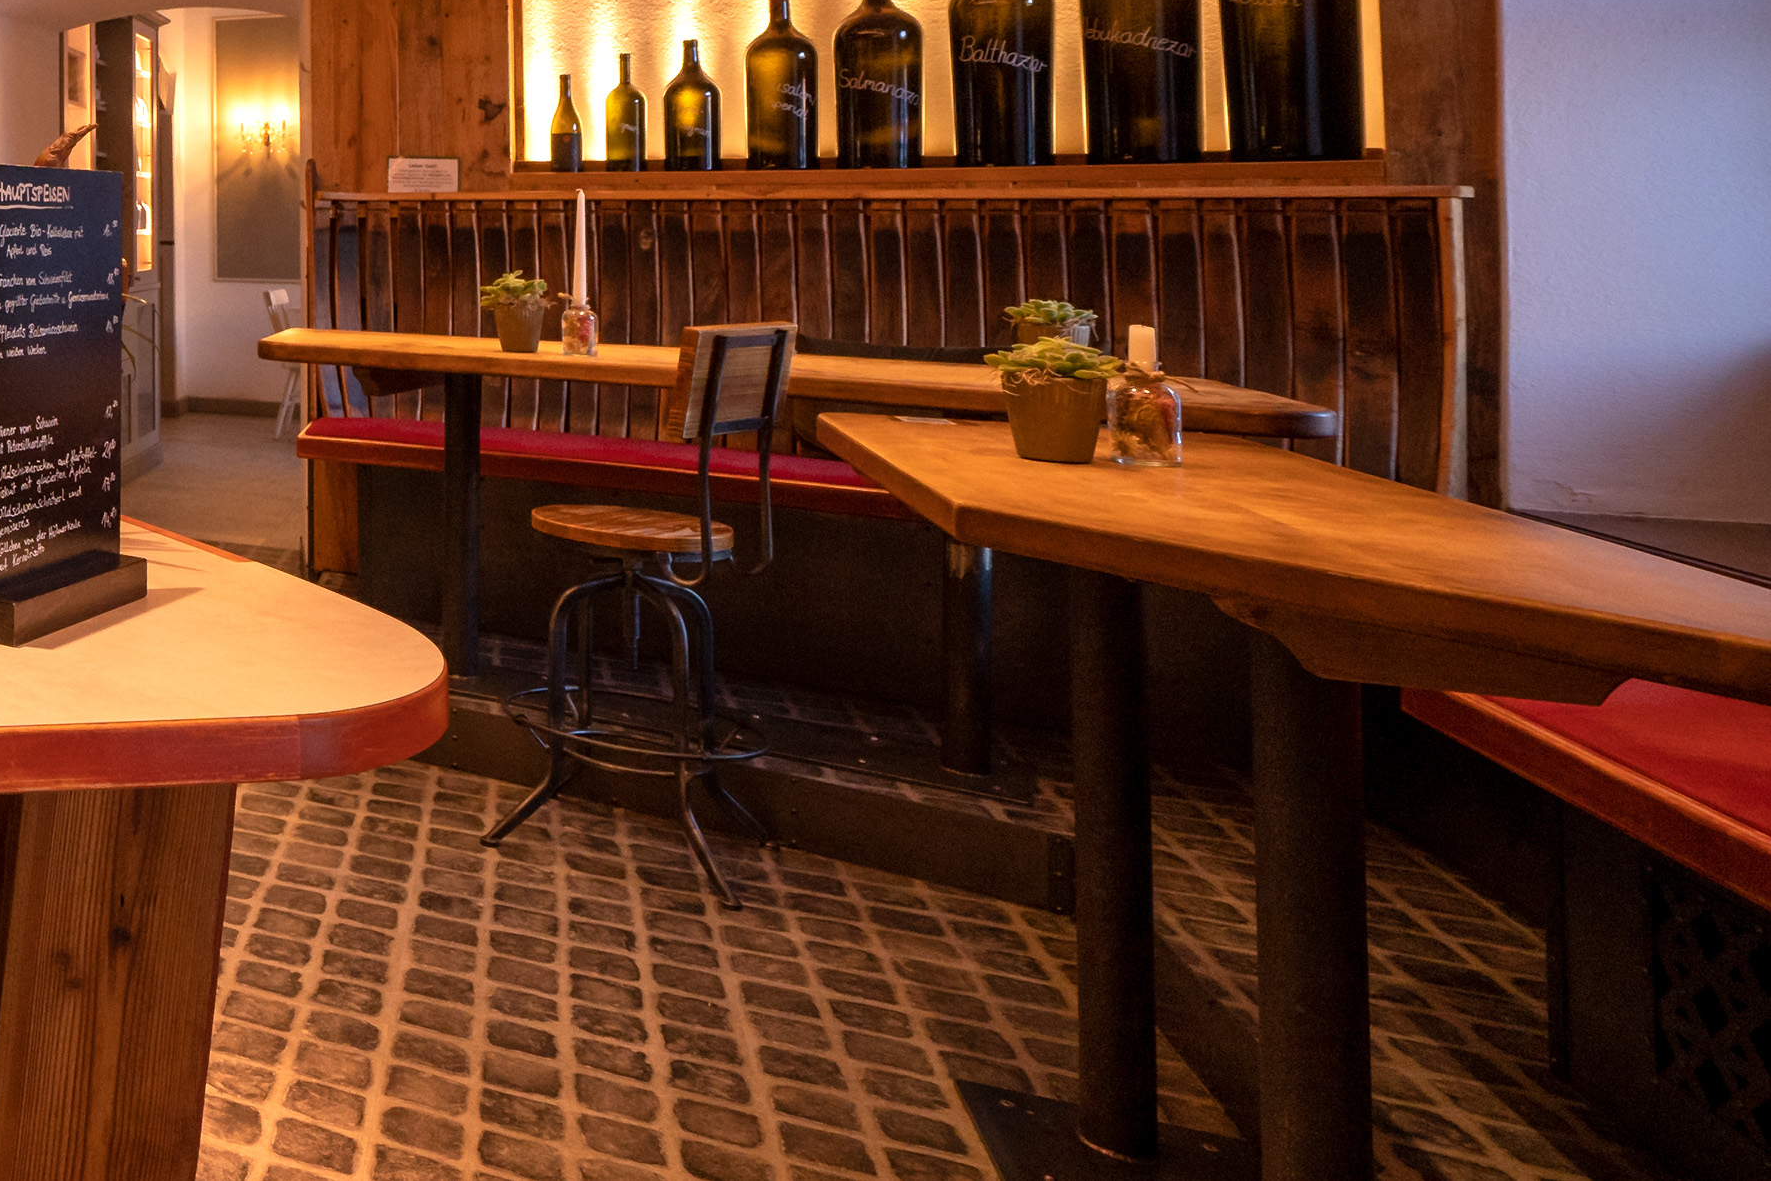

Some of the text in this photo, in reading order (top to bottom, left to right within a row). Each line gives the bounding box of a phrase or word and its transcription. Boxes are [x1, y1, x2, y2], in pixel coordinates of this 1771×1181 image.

[1085, 18, 1197, 58] ebukadnezar
[959, 35, 1048, 73] Balthazar
[69, 485, 82, 498] und
[36, 530, 47, 542] der
